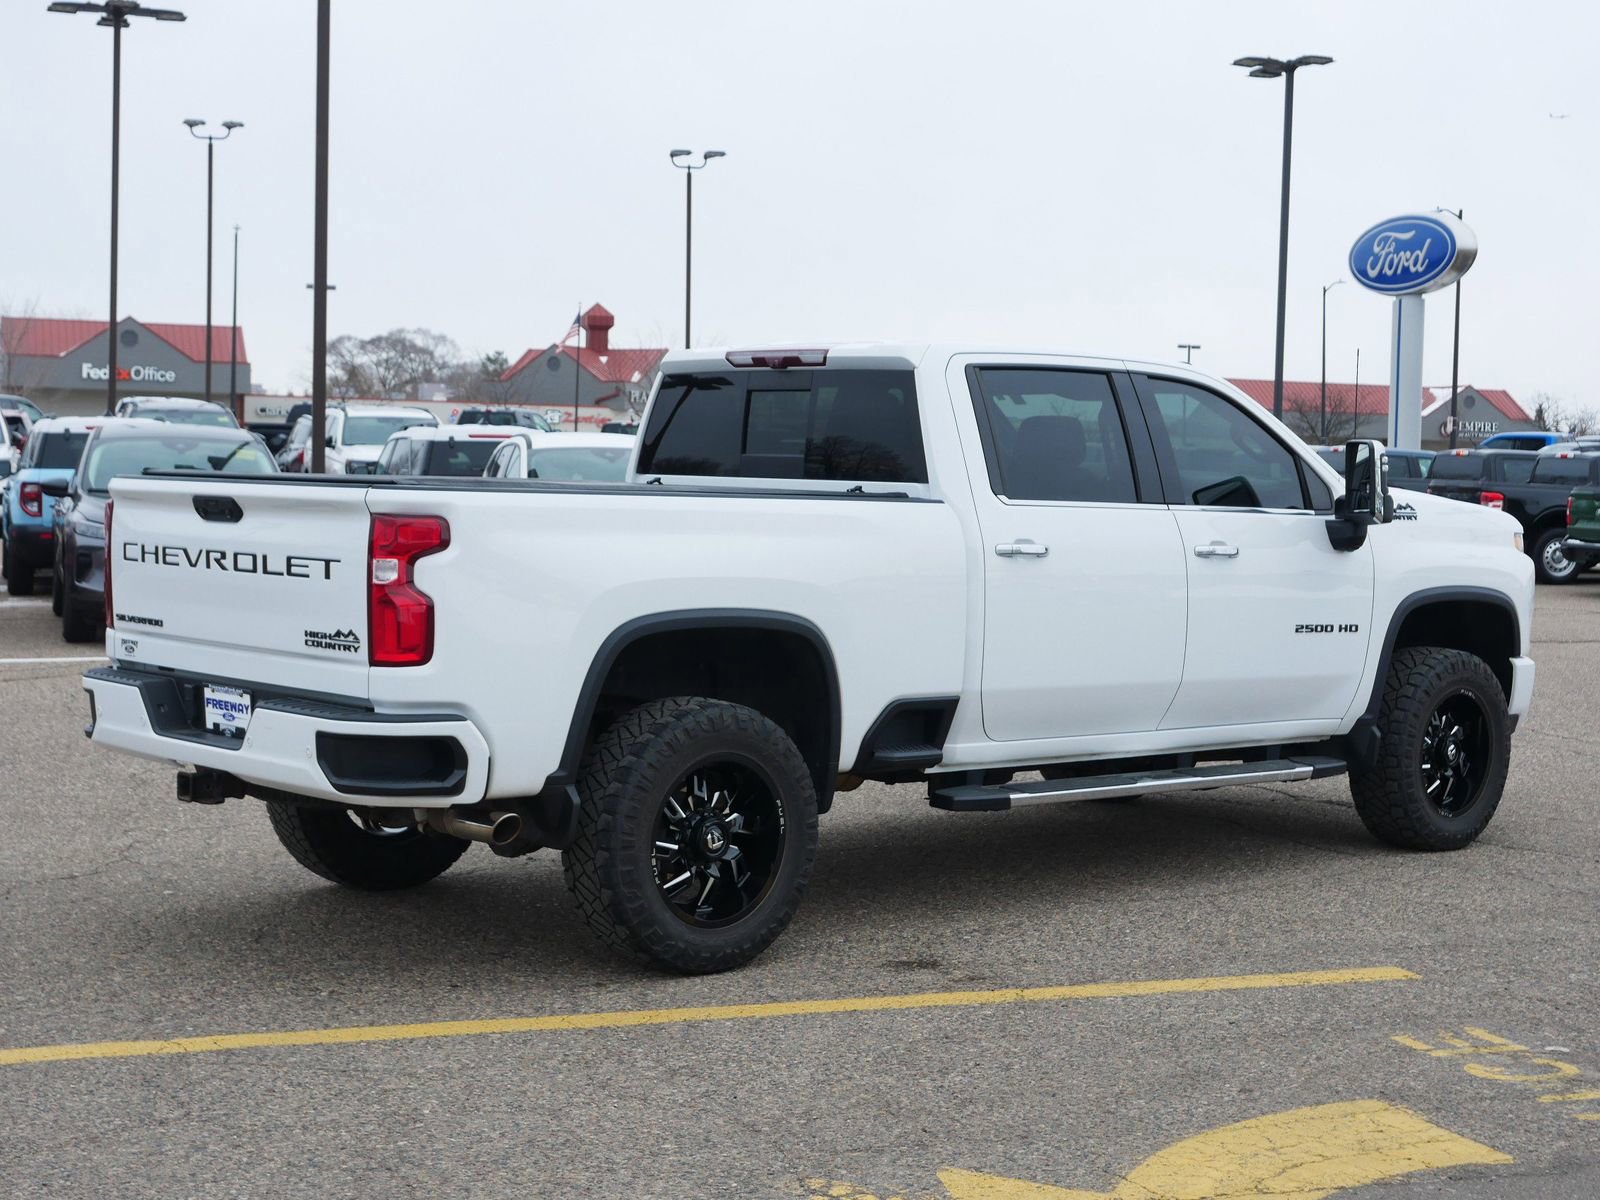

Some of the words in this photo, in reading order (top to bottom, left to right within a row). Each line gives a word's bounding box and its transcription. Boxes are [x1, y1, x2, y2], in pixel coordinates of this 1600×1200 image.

[1366, 230, 1431, 278] Ford
[131, 365, 176, 382] Office
[1458, 421, 1498, 432] EMPIRE
[123, 542, 342, 580] CHEVROLET
[116, 613, 164, 628] SILVERADO
[1295, 624, 1334, 633] 2500
[1338, 624, 1359, 633] HD
[304, 629, 333, 642] HIGH
[304, 639, 361, 653] COUNTRY
[206, 697, 250, 715] FREEWAY
[775, 799, 785, 834] FUEL
